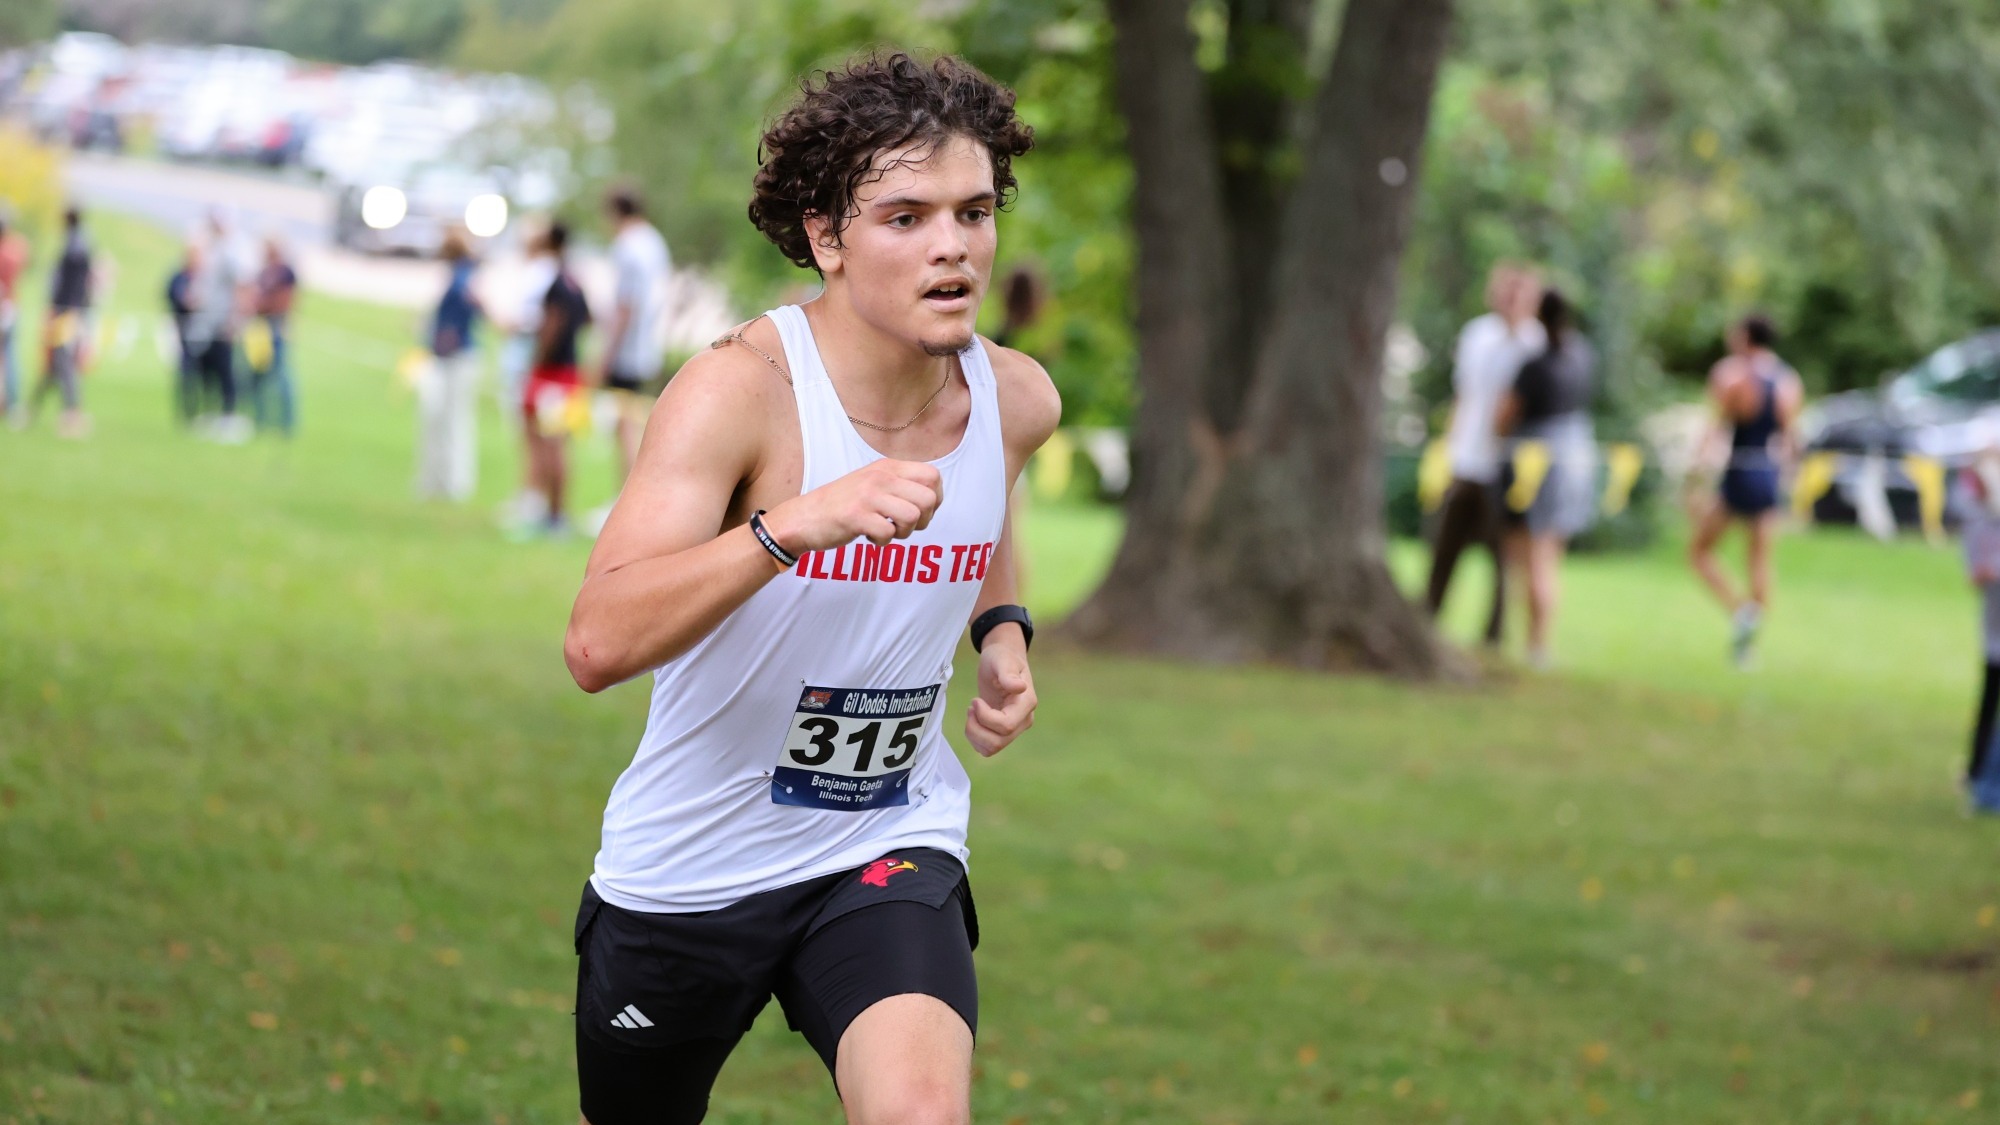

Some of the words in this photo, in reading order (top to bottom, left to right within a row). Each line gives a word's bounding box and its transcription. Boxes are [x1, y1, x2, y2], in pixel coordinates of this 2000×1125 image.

[796, 543, 943, 584] ILLINOIS
[949, 542, 993, 583] TEC
[843, 692, 858, 713] Gil
[857, 693, 888, 715] Dodds
[887, 688, 936, 714] Invitational
[789, 716, 926, 772] 315
[811, 775, 857, 791] Benjamin
[859, 780, 883, 792] Gaeta
[818, 790, 852, 802] Illinois
[854, 793, 873, 803] Tech
